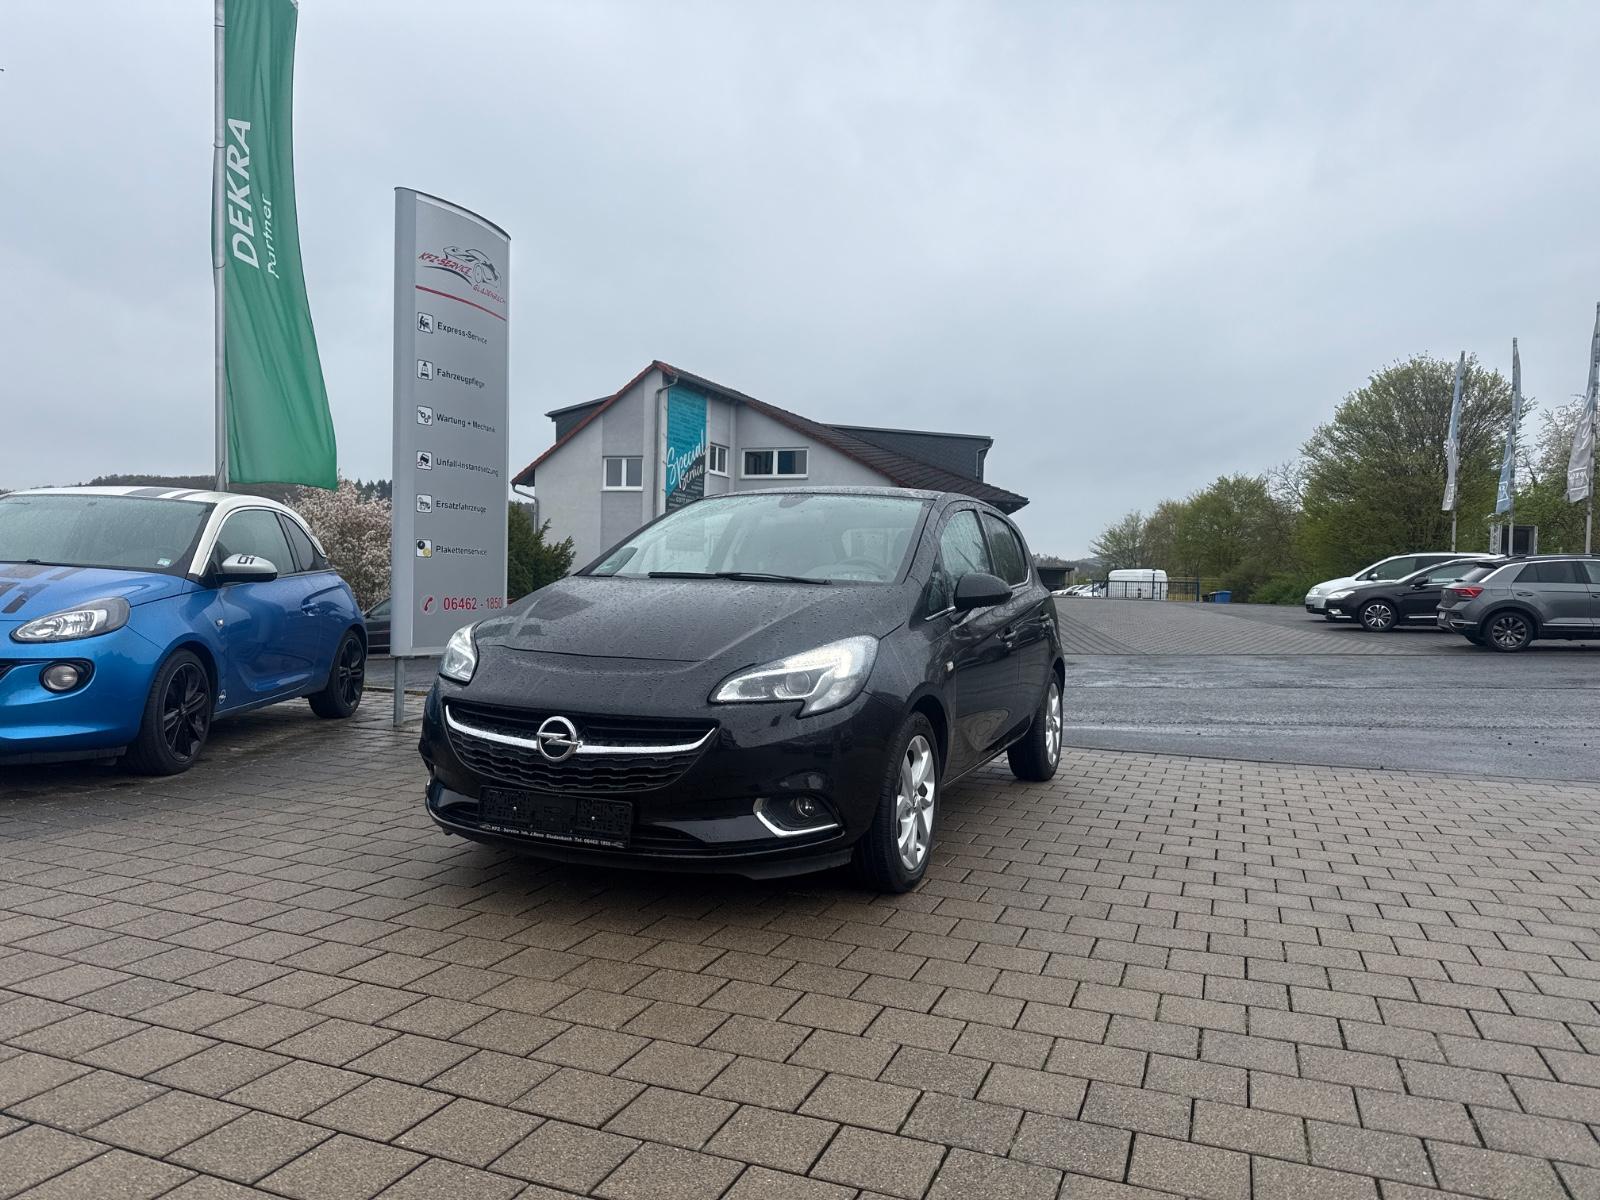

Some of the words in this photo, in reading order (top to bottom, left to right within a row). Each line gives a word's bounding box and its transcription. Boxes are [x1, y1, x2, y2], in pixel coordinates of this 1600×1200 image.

[226, 118, 260, 270] DEKRA
[262, 193, 280, 279] partner
[437, 321, 488, 344] Express-Service
[436, 413, 466, 428] Wartung
[666, 429, 706, 489] Special
[436, 500, 487, 513] Ersatzfahrzeuge
[435, 545, 487, 556] Plakettenservice
[443, 597, 477, 610] 06462
[486, 597, 503, 610] 1850
